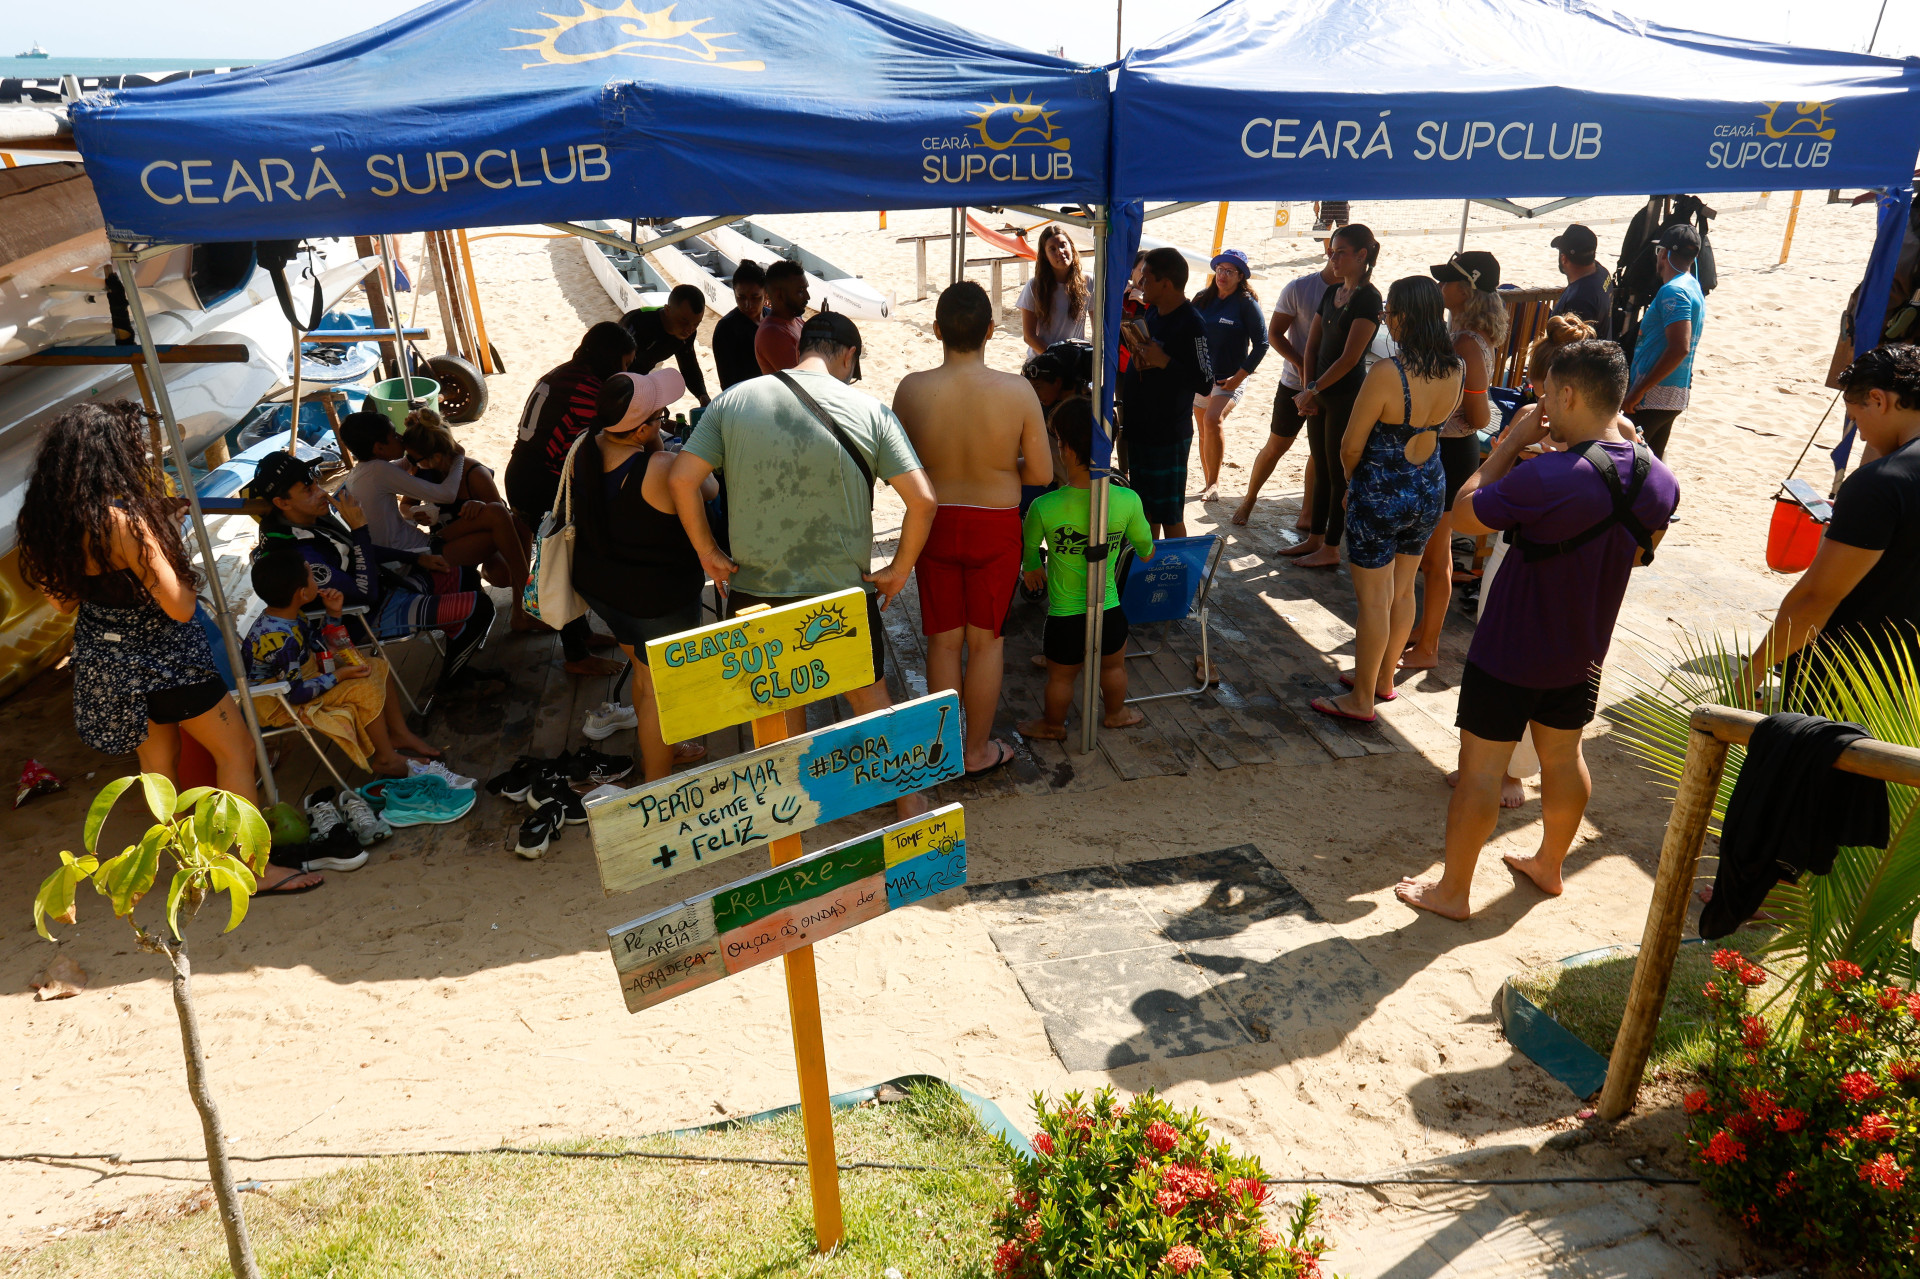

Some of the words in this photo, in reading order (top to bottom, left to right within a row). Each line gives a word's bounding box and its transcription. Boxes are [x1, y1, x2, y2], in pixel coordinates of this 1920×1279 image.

[921, 133, 972, 150] CEARÁ
[1241, 110, 1393, 159] CEARÁ
[1413, 121, 1603, 160] SUPCLUB
[1713, 122, 1755, 137] CEARÁ
[140, 145, 347, 205] CEARÁ
[366, 144, 611, 197] SUPCLUB
[922, 152, 1074, 184] SUPCLUB
[1705, 141, 1832, 169] SUPCLUB
[722, 638, 784, 680] SUP
[750, 658, 830, 704] CLUB
[808, 734, 892, 779] #BORA
[854, 744, 927, 785] REMAR
[628, 778, 705, 828] PERTO
[710, 776, 730, 795] do
[732, 759, 782, 795] MAR
[678, 821, 693, 836] A
[756, 786, 766, 806] É
[892, 828, 924, 849] TOME
[929, 821, 947, 835] UM
[927, 831, 965, 861] SOL
[801, 898, 847, 929] ONDAS
[884, 871, 922, 897] MAR
[647, 932, 690, 958] AREIA
